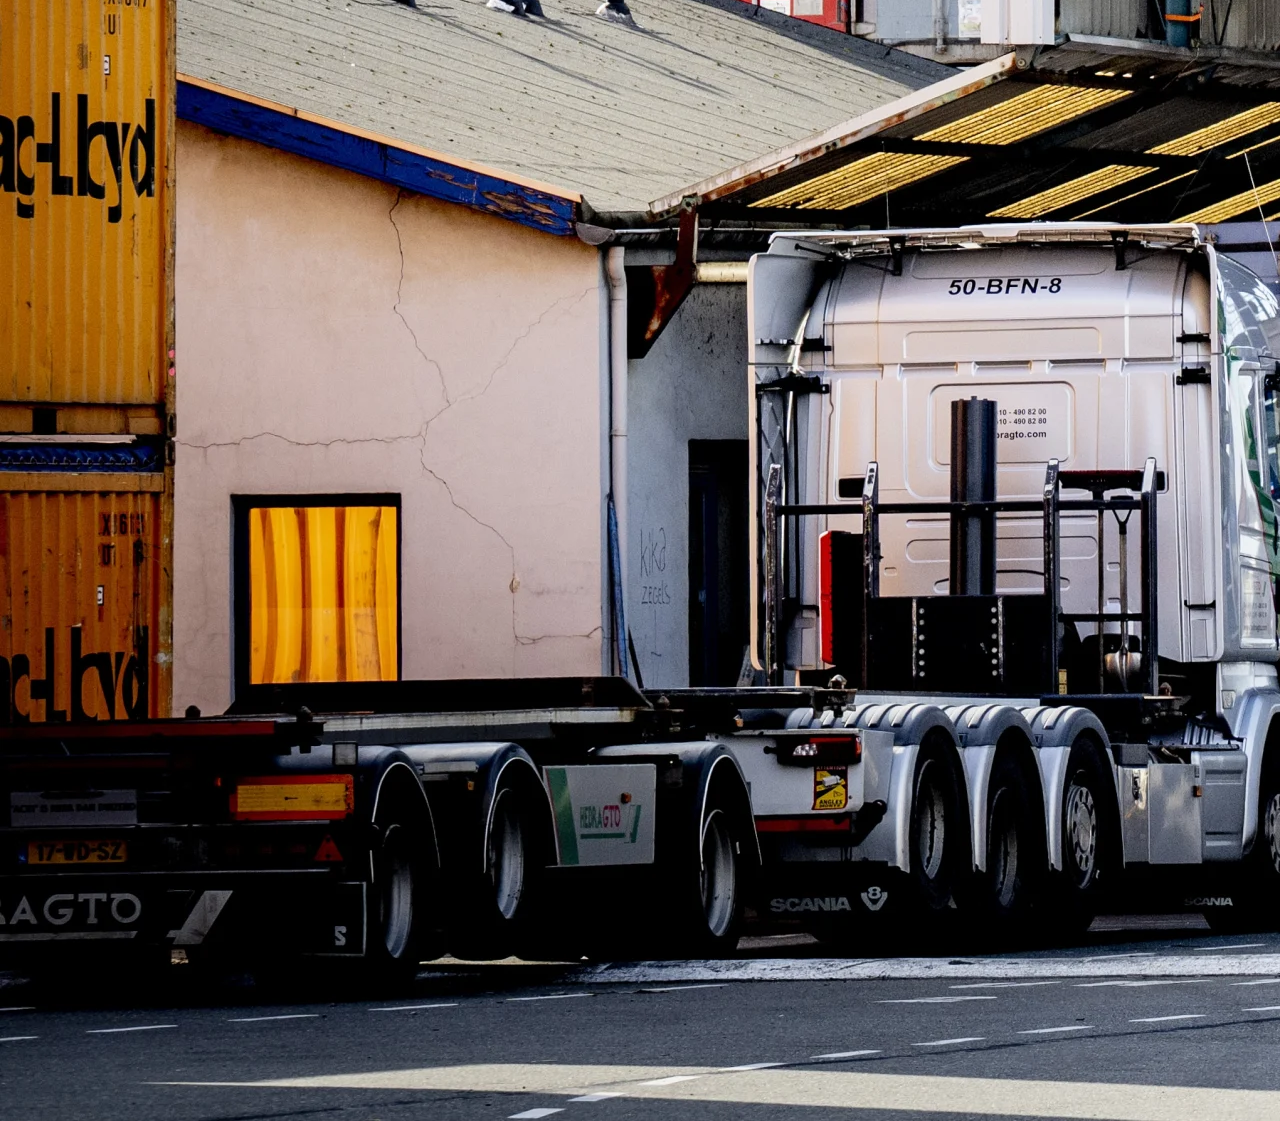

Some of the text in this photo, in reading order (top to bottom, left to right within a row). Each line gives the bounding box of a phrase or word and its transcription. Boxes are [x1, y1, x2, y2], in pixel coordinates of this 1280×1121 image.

[948, 277, 1062, 296] 50-BFN-8
[1013, 408, 1026, 416] 490
[1027, 408, 1037, 416] 82
[1013, 417, 1026, 425] 490
[1027, 417, 1037, 425] 82
[770, 896, 852, 913] SCANIA
